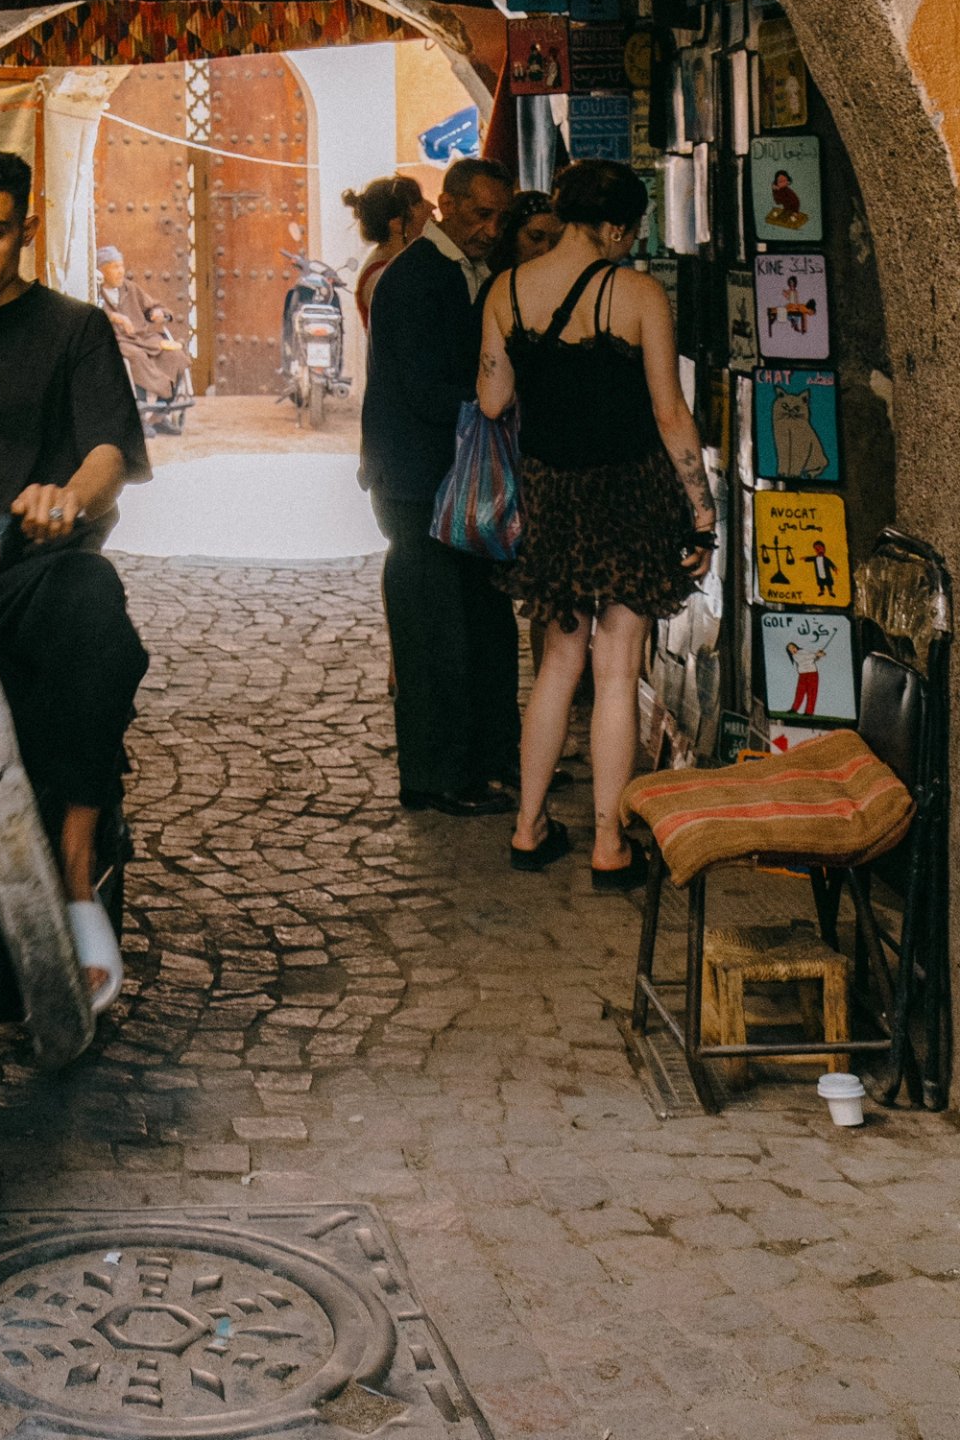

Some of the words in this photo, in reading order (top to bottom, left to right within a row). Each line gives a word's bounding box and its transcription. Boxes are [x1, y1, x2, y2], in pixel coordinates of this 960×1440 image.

[756, 369, 791, 385] CHAT
[770, 507, 817, 520] AVOCAT
[767, 590, 804, 601] AVOCAT
[763, 616, 793, 629] GOLF
